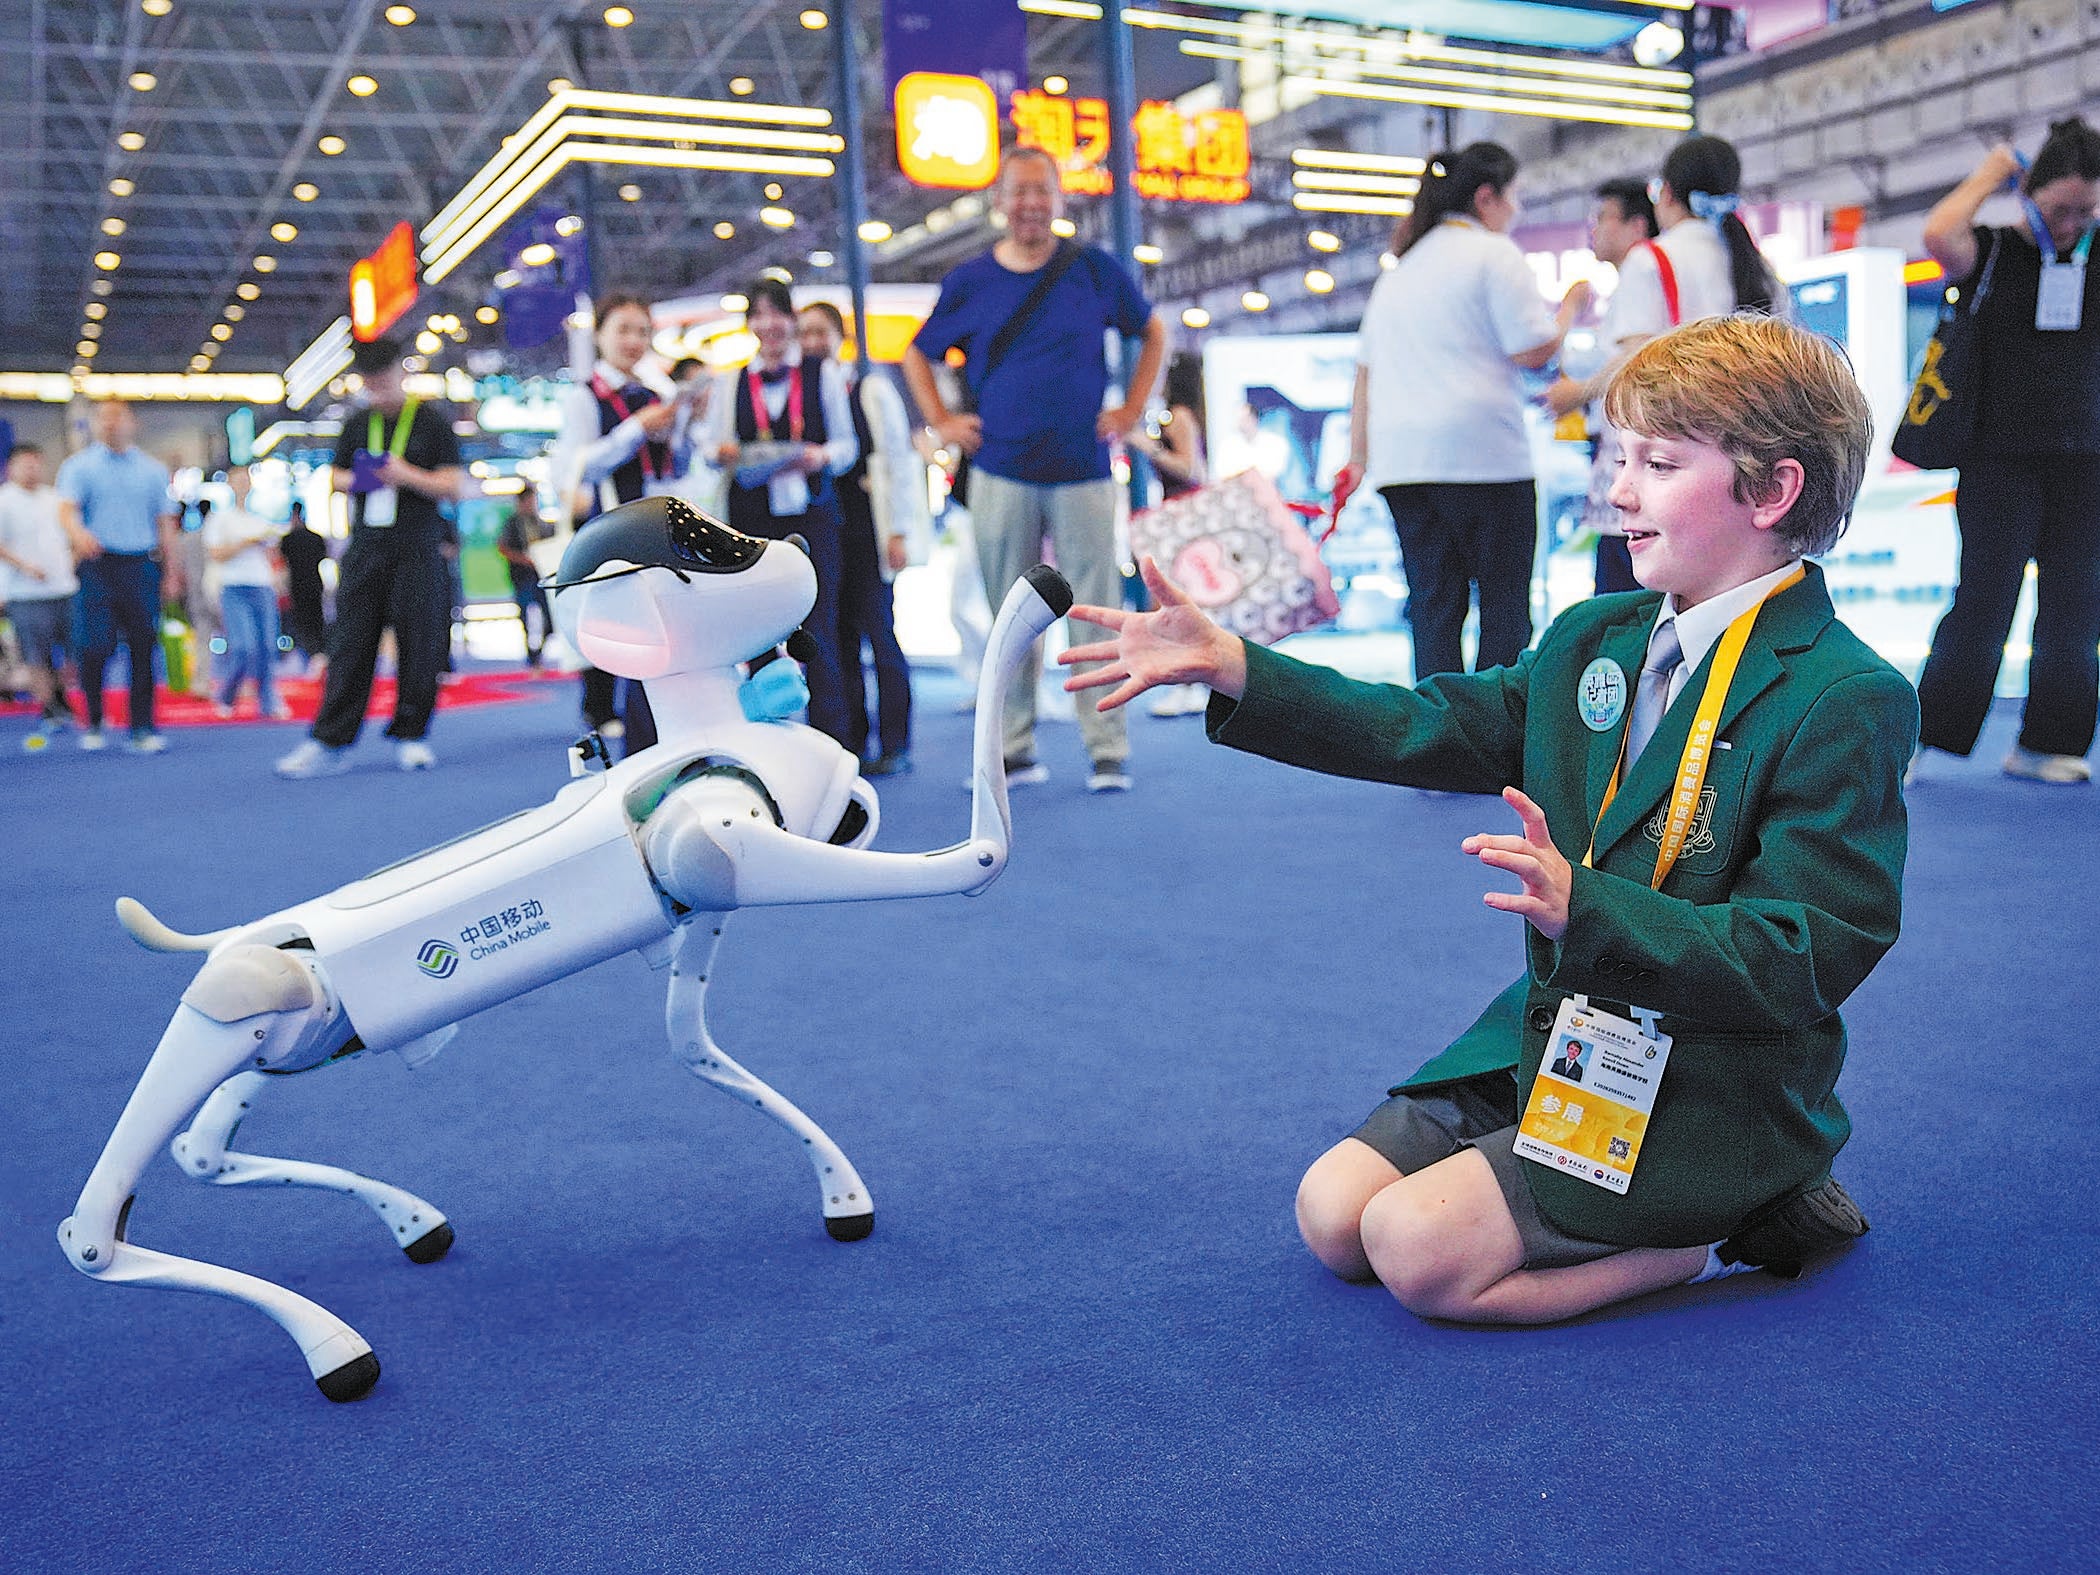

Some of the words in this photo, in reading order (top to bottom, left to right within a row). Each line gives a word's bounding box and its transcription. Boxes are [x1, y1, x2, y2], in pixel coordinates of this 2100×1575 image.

[460, 899, 544, 944] 中国移动
[470, 938, 509, 961] China
[508, 920, 552, 945] Mobile
[1541, 1094, 1585, 1127] 参展
